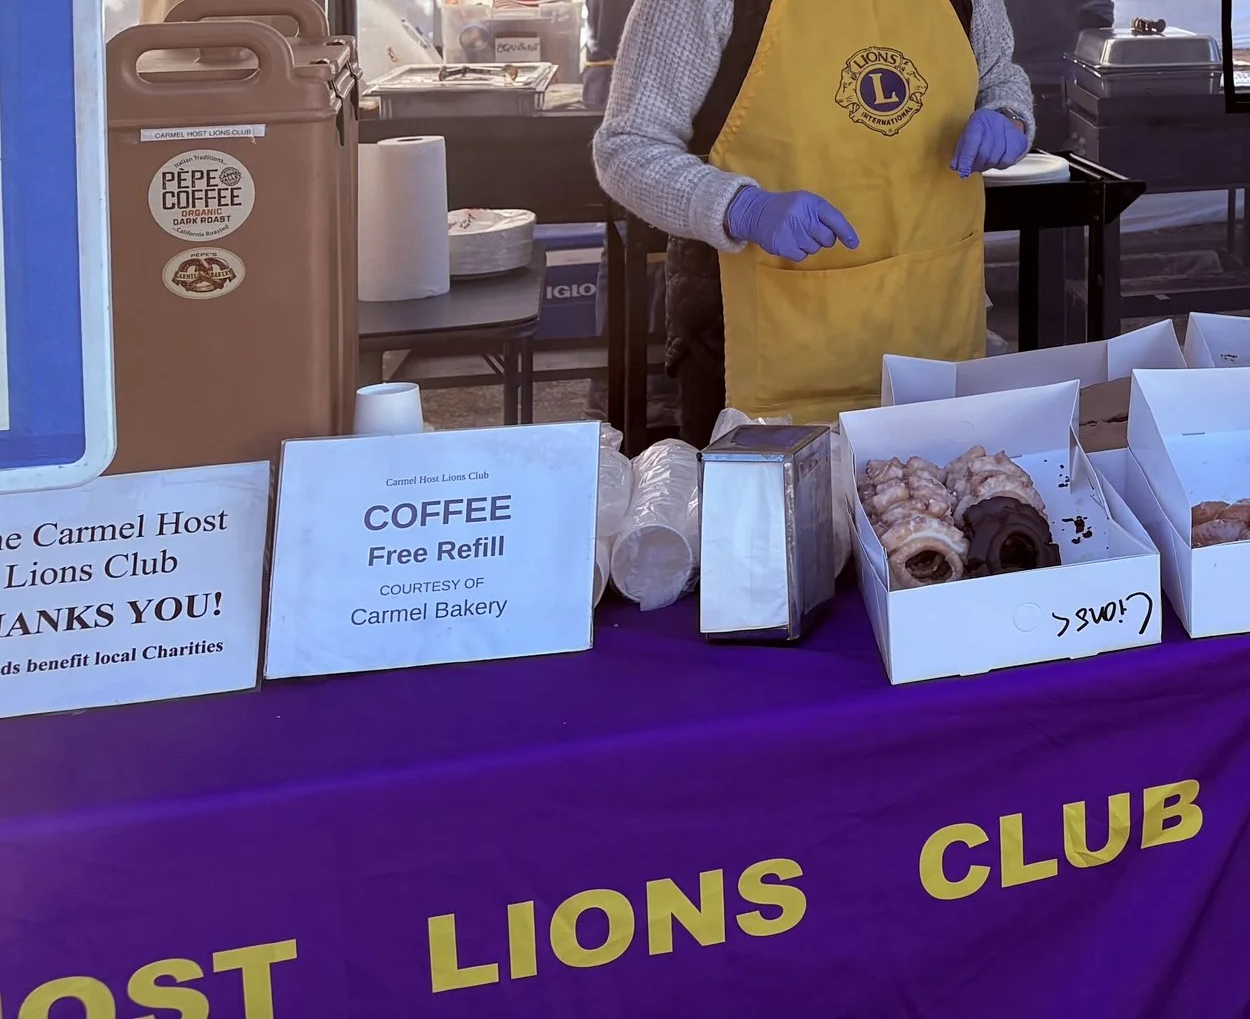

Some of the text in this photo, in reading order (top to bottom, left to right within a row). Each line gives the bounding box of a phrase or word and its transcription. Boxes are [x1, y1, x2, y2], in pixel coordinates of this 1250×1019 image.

[853, 51, 898, 69] LIONS
[869, 73, 900, 104] L
[861, 106, 914, 126] INTERNATIONAL
[154, 132, 185, 140] CARMEL
[162, 187, 241, 210] COFFEE
[181, 208, 222, 217] ORGANIC
[173, 215, 231, 225] DARK ROAST
[385, 471, 489, 487] Carmel Host Lions Club
[363, 494, 512, 531] COFFEE
[33, 514, 145, 548] Carmel
[156, 509, 229, 537] Host
[367, 535, 505, 567] Free Refill
[4, 549, 178, 589] Lions Club
[379, 577, 485, 596] COURTESY OF
[0, 591, 222, 639] ANKS YOU!
[350, 597, 508, 626] Carmel Bakery
[26, 653, 90, 674] benefit
[94, 648, 137, 666] local
[142, 639, 224, 660] Charities
[426, 857, 808, 993] LIONS
[917, 778, 1205, 901] CLUB
